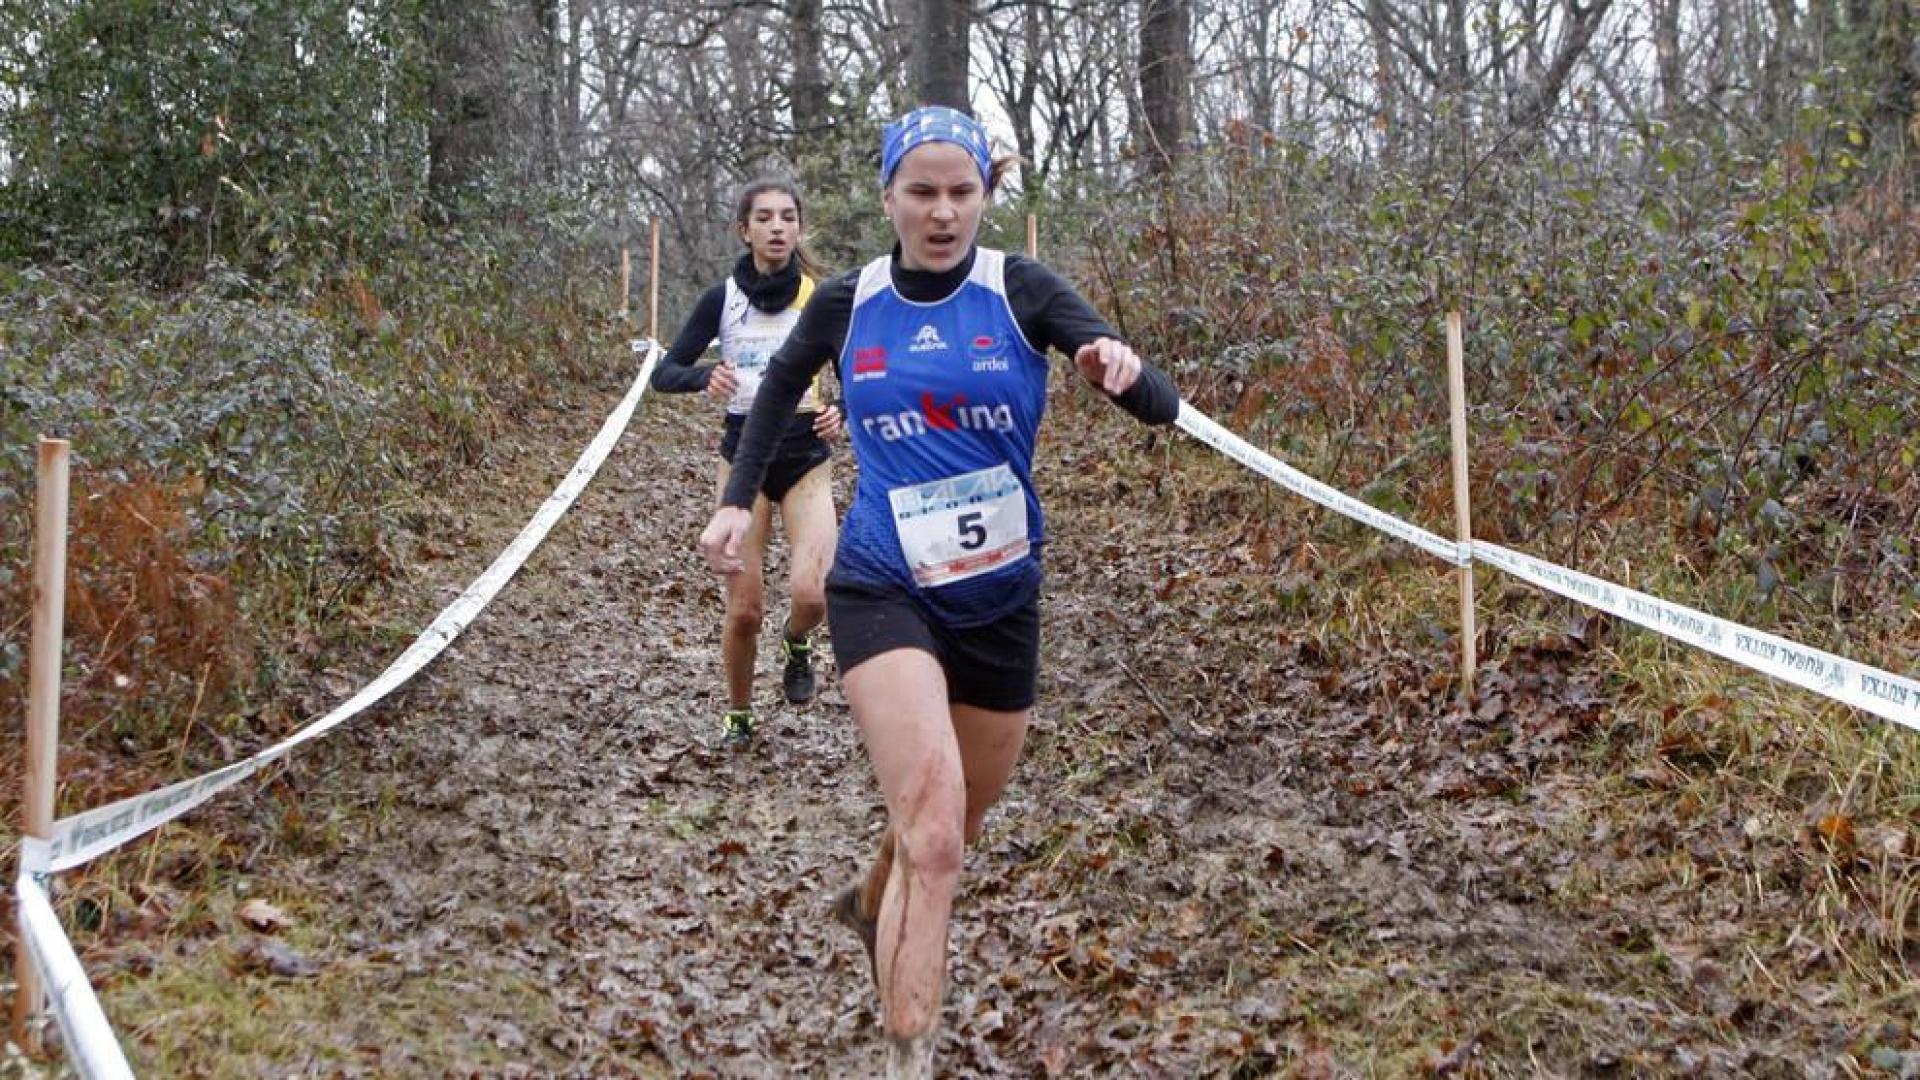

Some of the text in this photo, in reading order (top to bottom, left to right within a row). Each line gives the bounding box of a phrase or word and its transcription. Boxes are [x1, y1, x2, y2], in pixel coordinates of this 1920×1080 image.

[958, 512, 987, 550] 5
[1665, 611, 1705, 635] RURAL
[1781, 648, 1825, 678] RURAL
